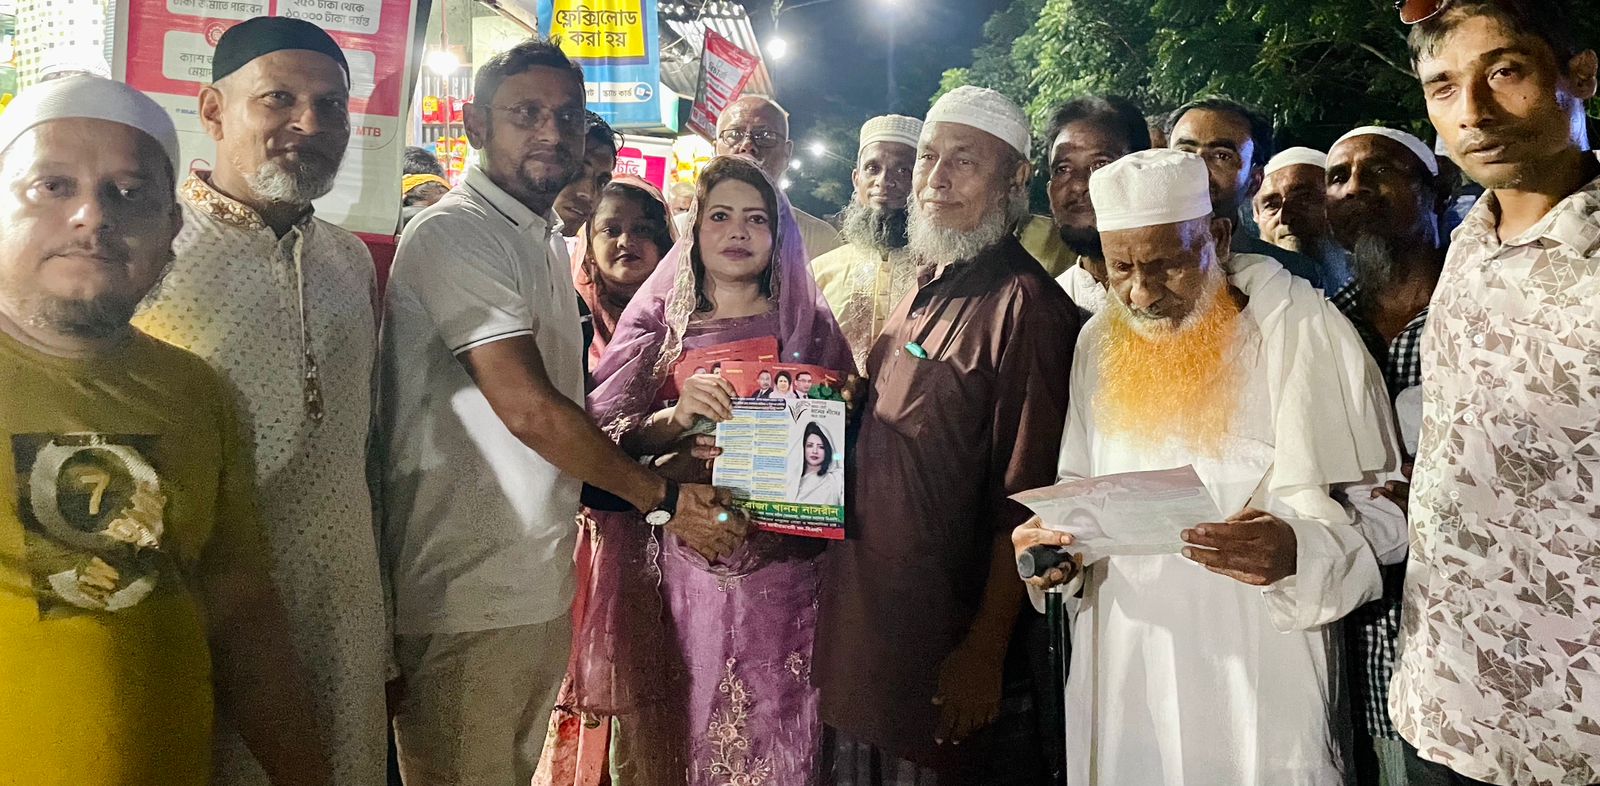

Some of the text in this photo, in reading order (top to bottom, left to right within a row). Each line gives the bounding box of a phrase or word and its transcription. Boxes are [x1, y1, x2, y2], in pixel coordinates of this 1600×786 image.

[317, 0, 338, 10] টাকা
[340, 2, 365, 13] থেকে
[556, 5, 638, 28] ফ্লেক্সিলোড
[568, 30, 627, 48] করা হয়
[80, 474, 103, 515] 7
